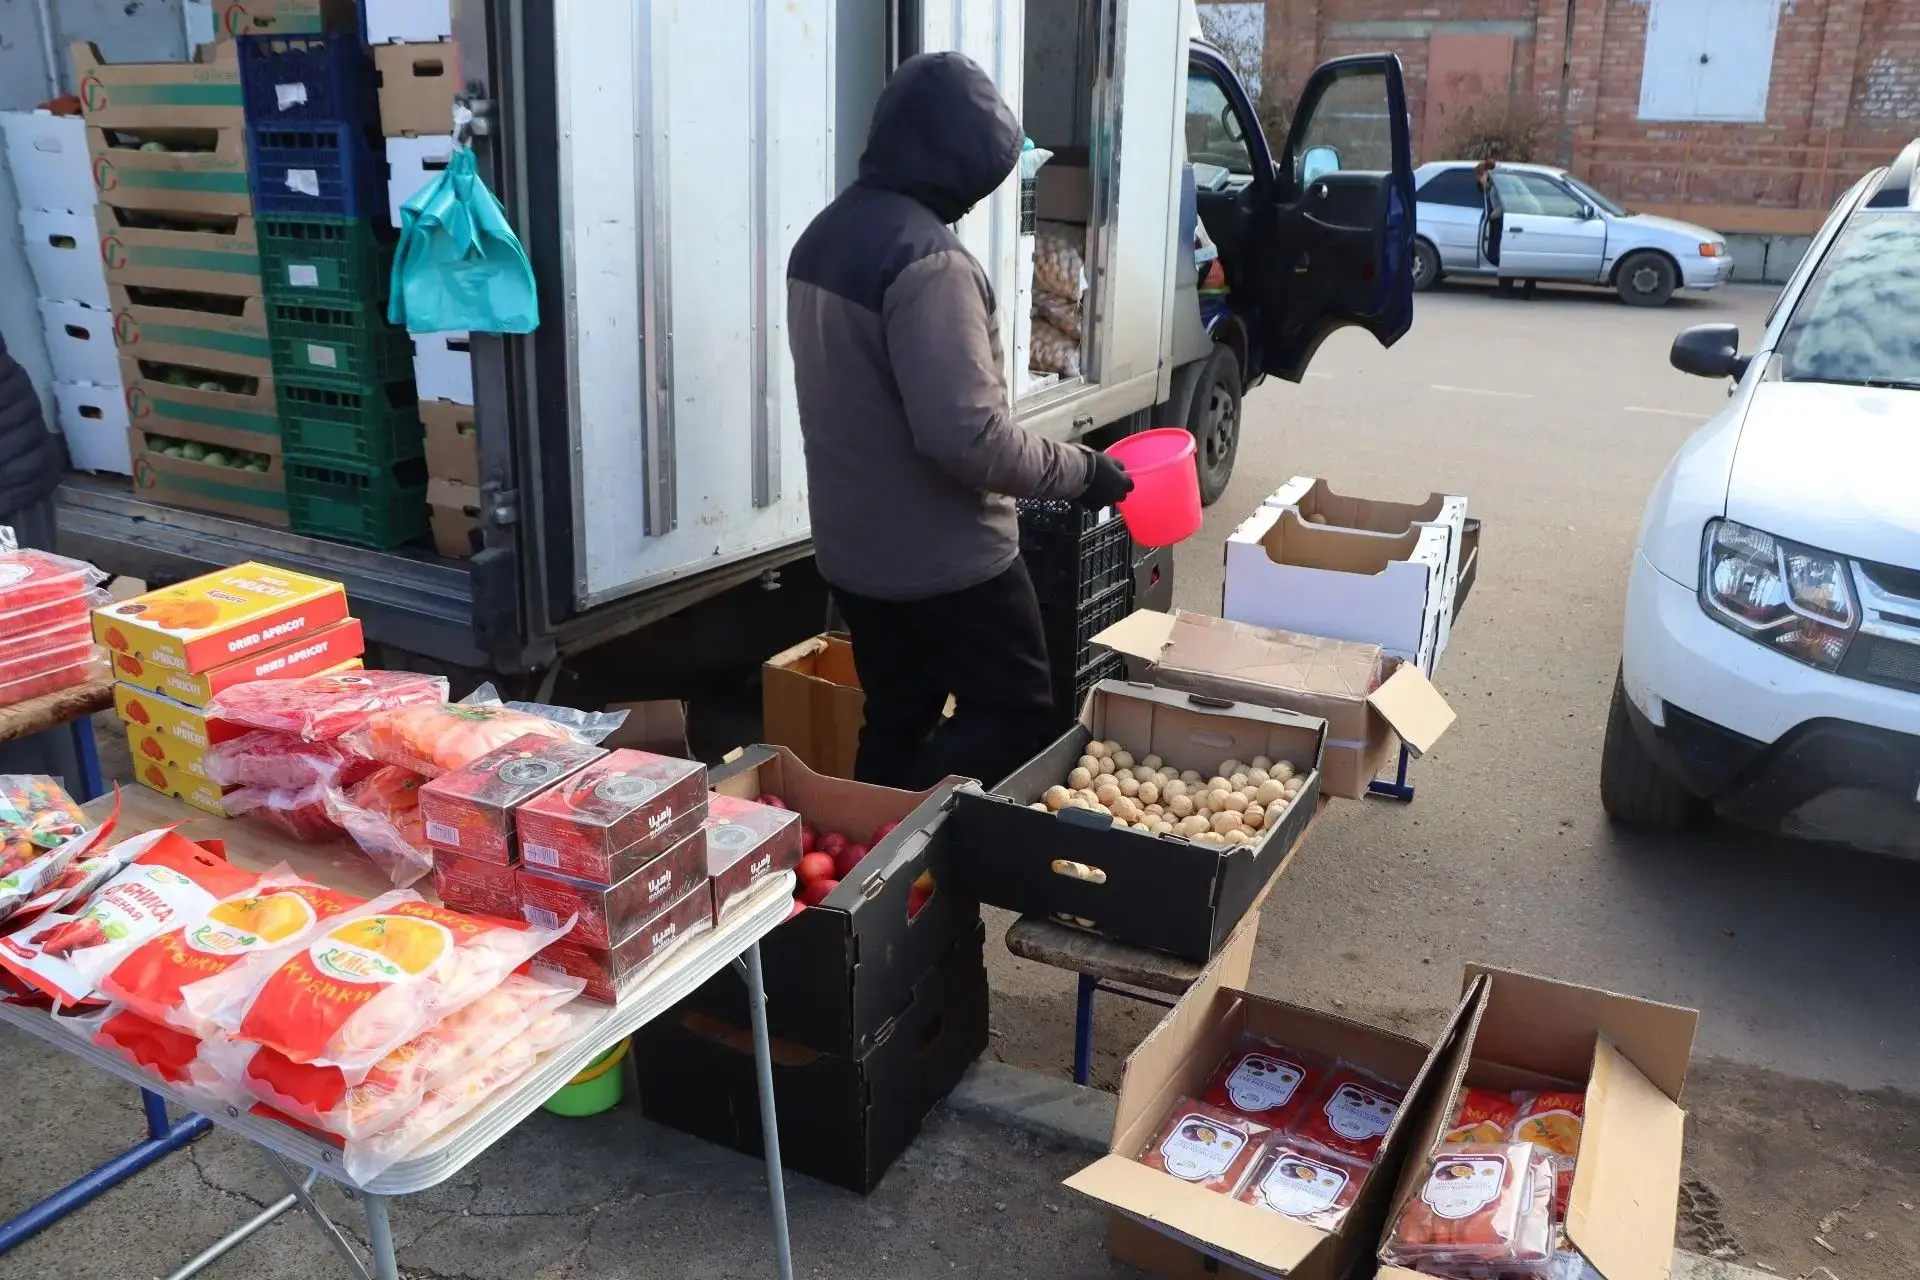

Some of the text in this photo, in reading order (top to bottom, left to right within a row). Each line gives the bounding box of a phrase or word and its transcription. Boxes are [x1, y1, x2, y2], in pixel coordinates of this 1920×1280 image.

[228, 616, 305, 653] DRIED APRICOT
[256, 641, 329, 677] DRIED APRICOT
